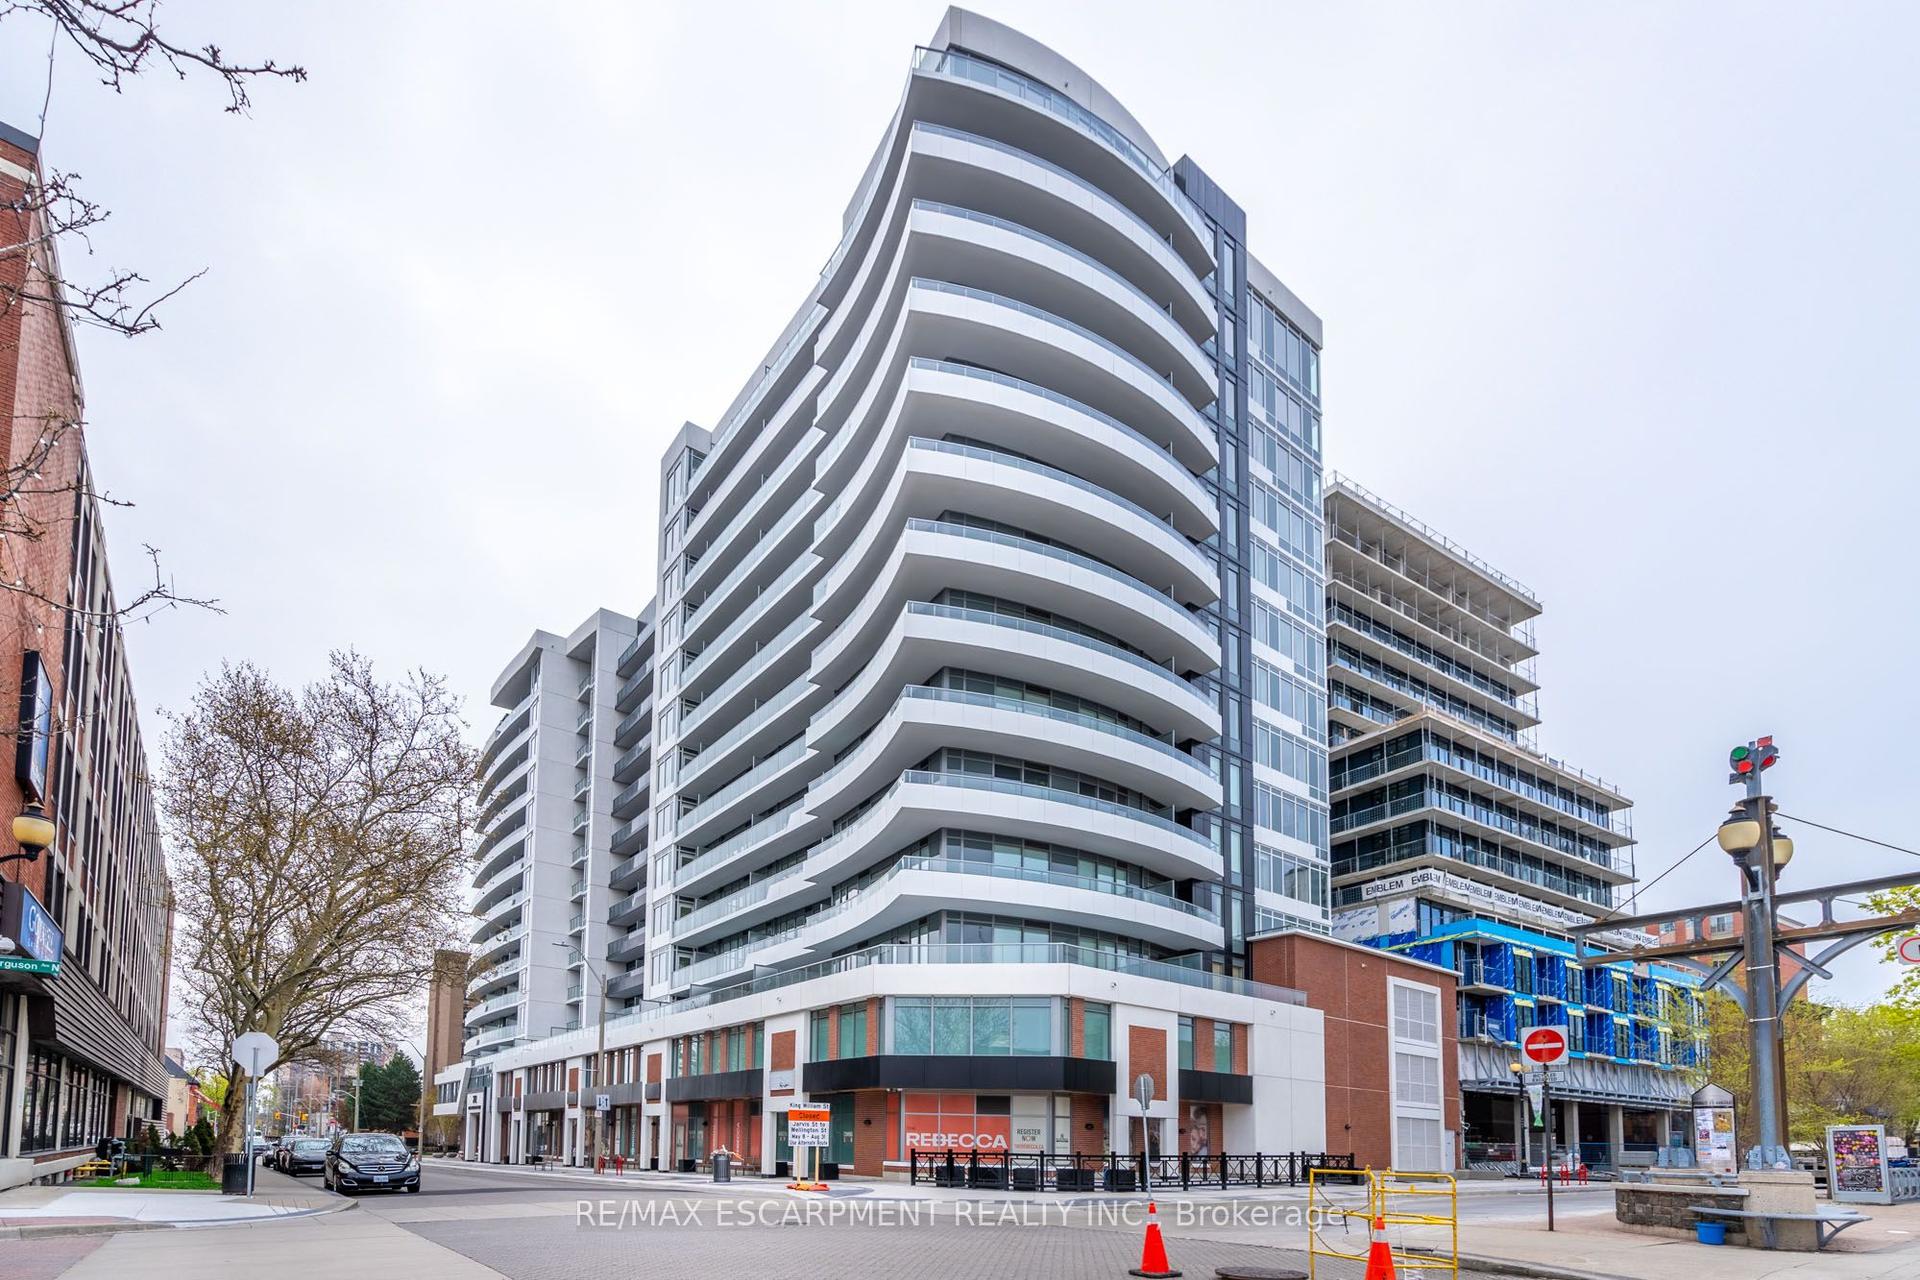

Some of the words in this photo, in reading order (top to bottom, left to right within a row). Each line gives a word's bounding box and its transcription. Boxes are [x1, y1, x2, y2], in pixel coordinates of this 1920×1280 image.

[1366, 880, 1404, 896] EMBLEM
[52, 964, 60, 972] N
[799, 1112, 820, 1120] Closed
[905, 1132, 1008, 1149] REBECCA
